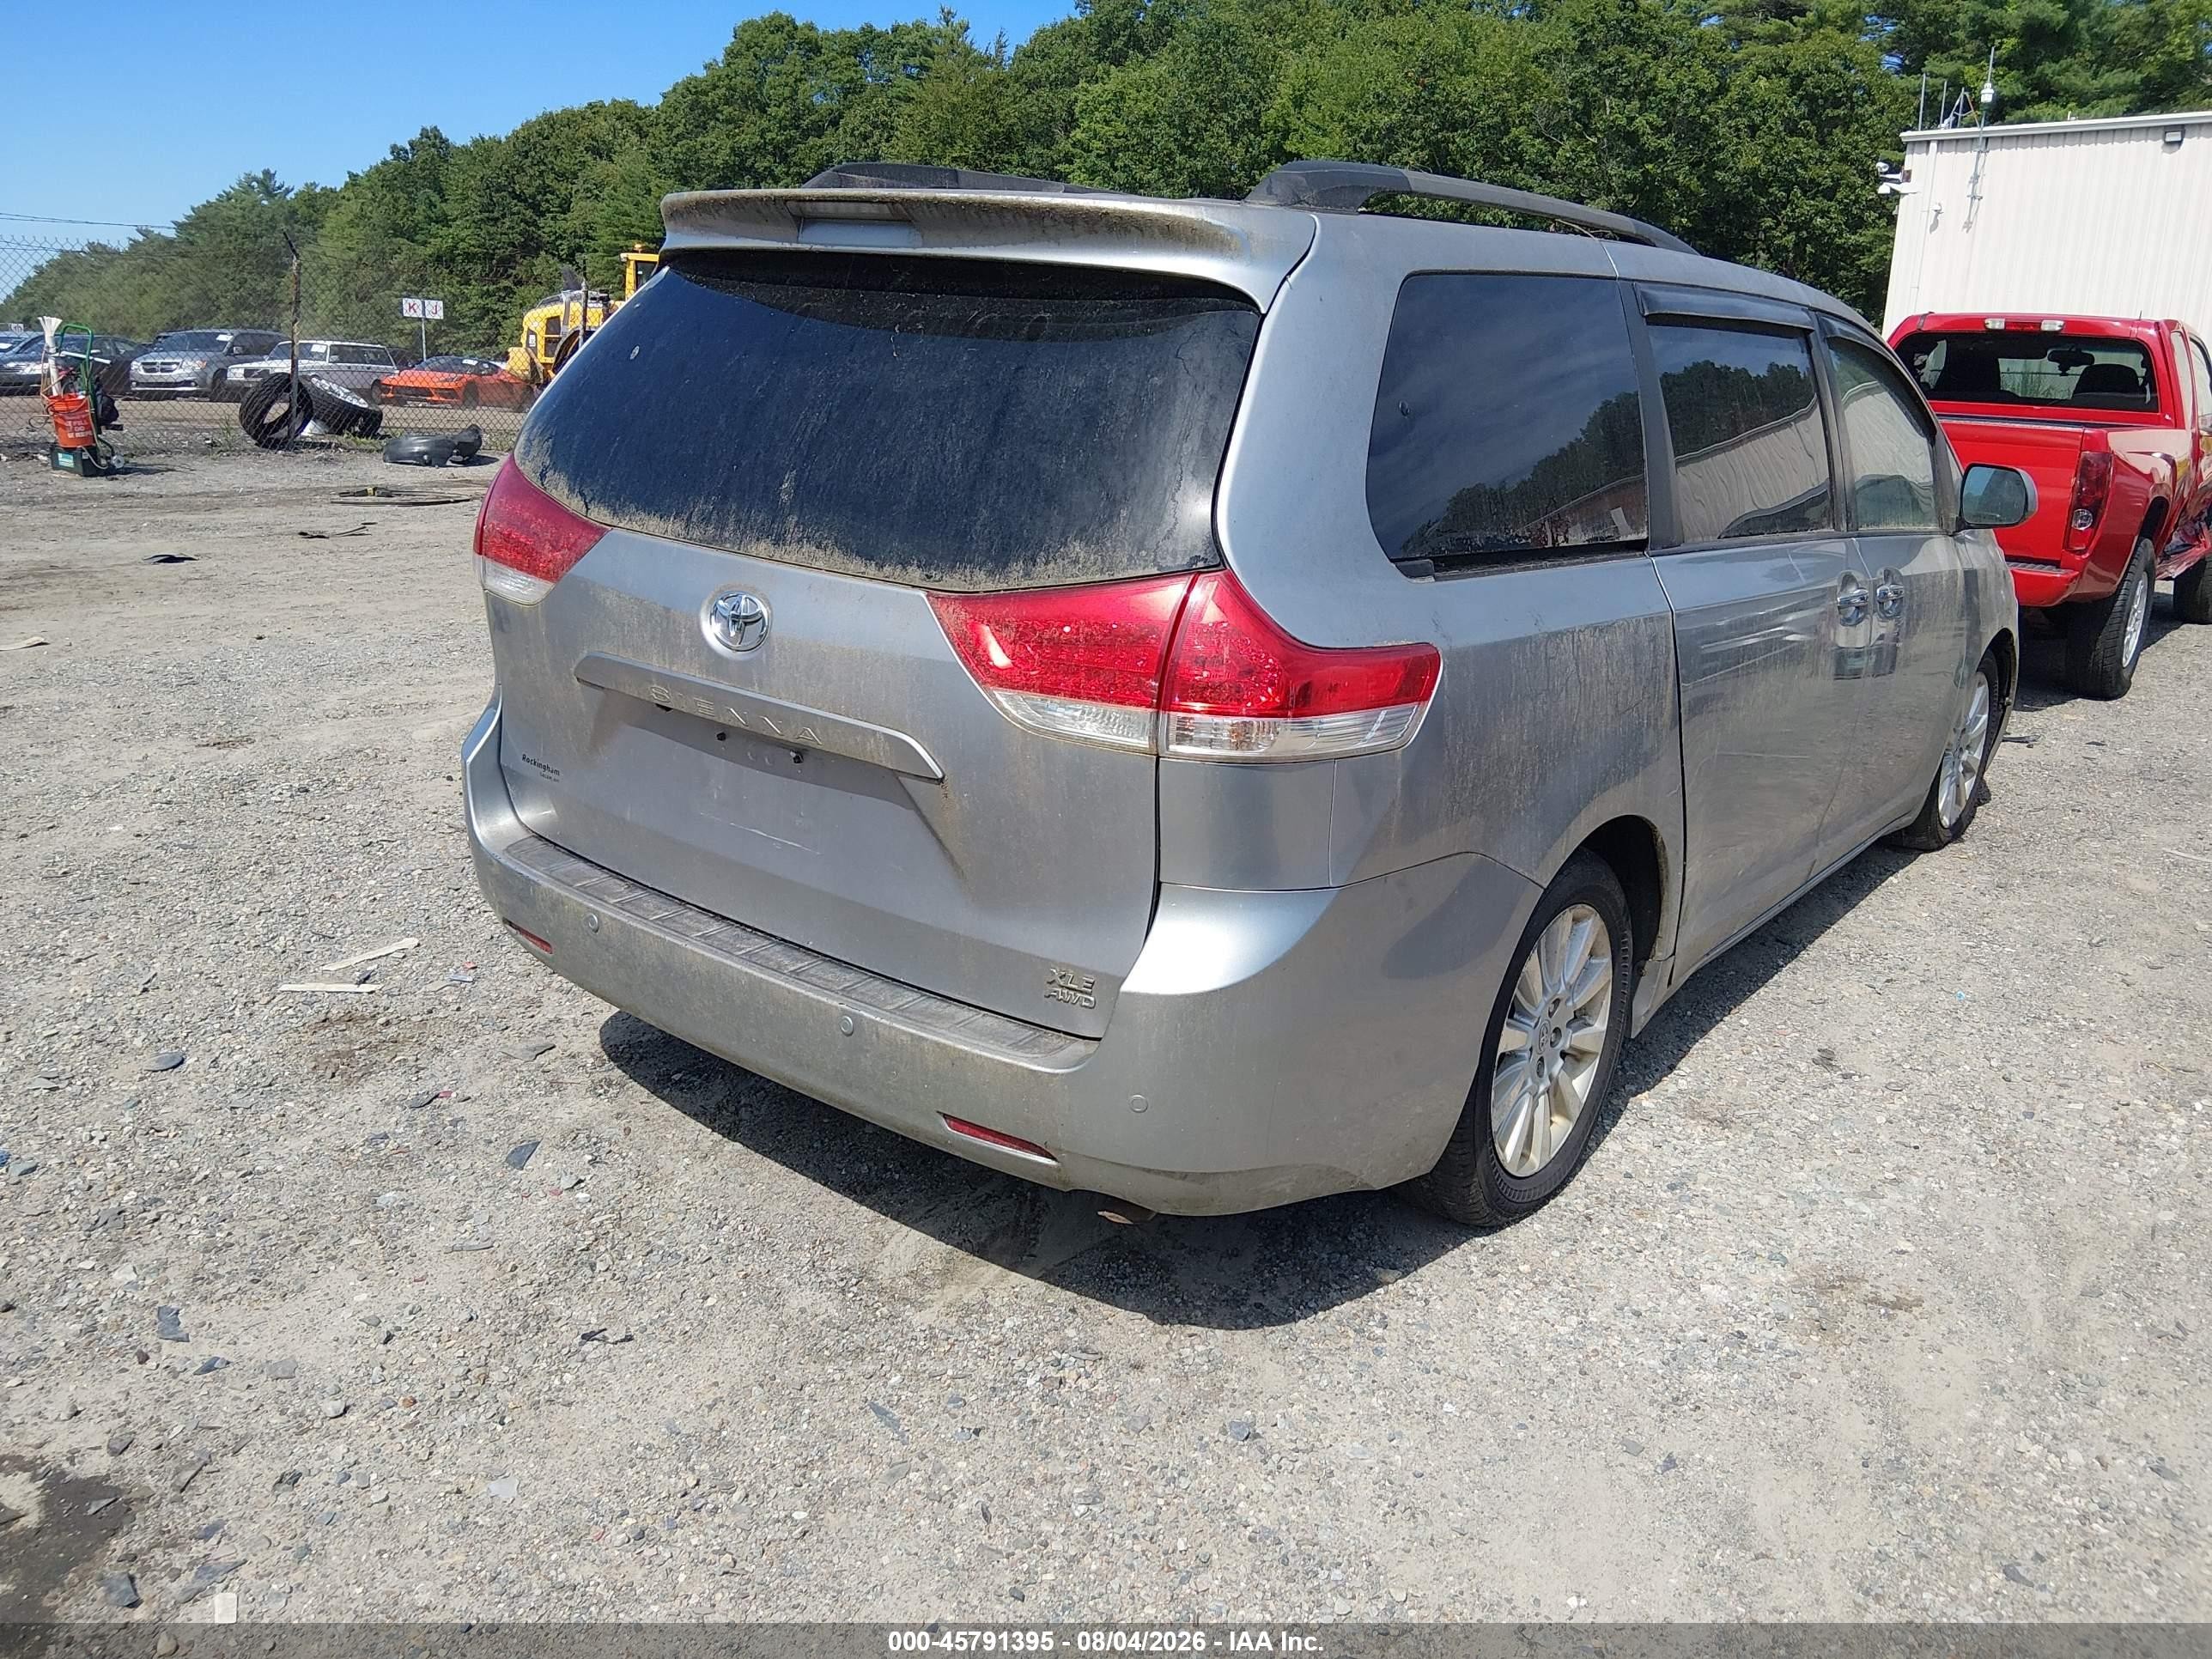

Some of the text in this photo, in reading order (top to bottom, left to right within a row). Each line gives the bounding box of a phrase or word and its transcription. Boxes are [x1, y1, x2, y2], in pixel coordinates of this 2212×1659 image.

[408, 302, 417, 313] K
[431, 304, 438, 315] J
[650, 684, 825, 745] SENNA
[522, 753, 560, 776] Rockingham
[1047, 968, 1095, 994] XLE
[1044, 988, 1097, 1009] AWD
